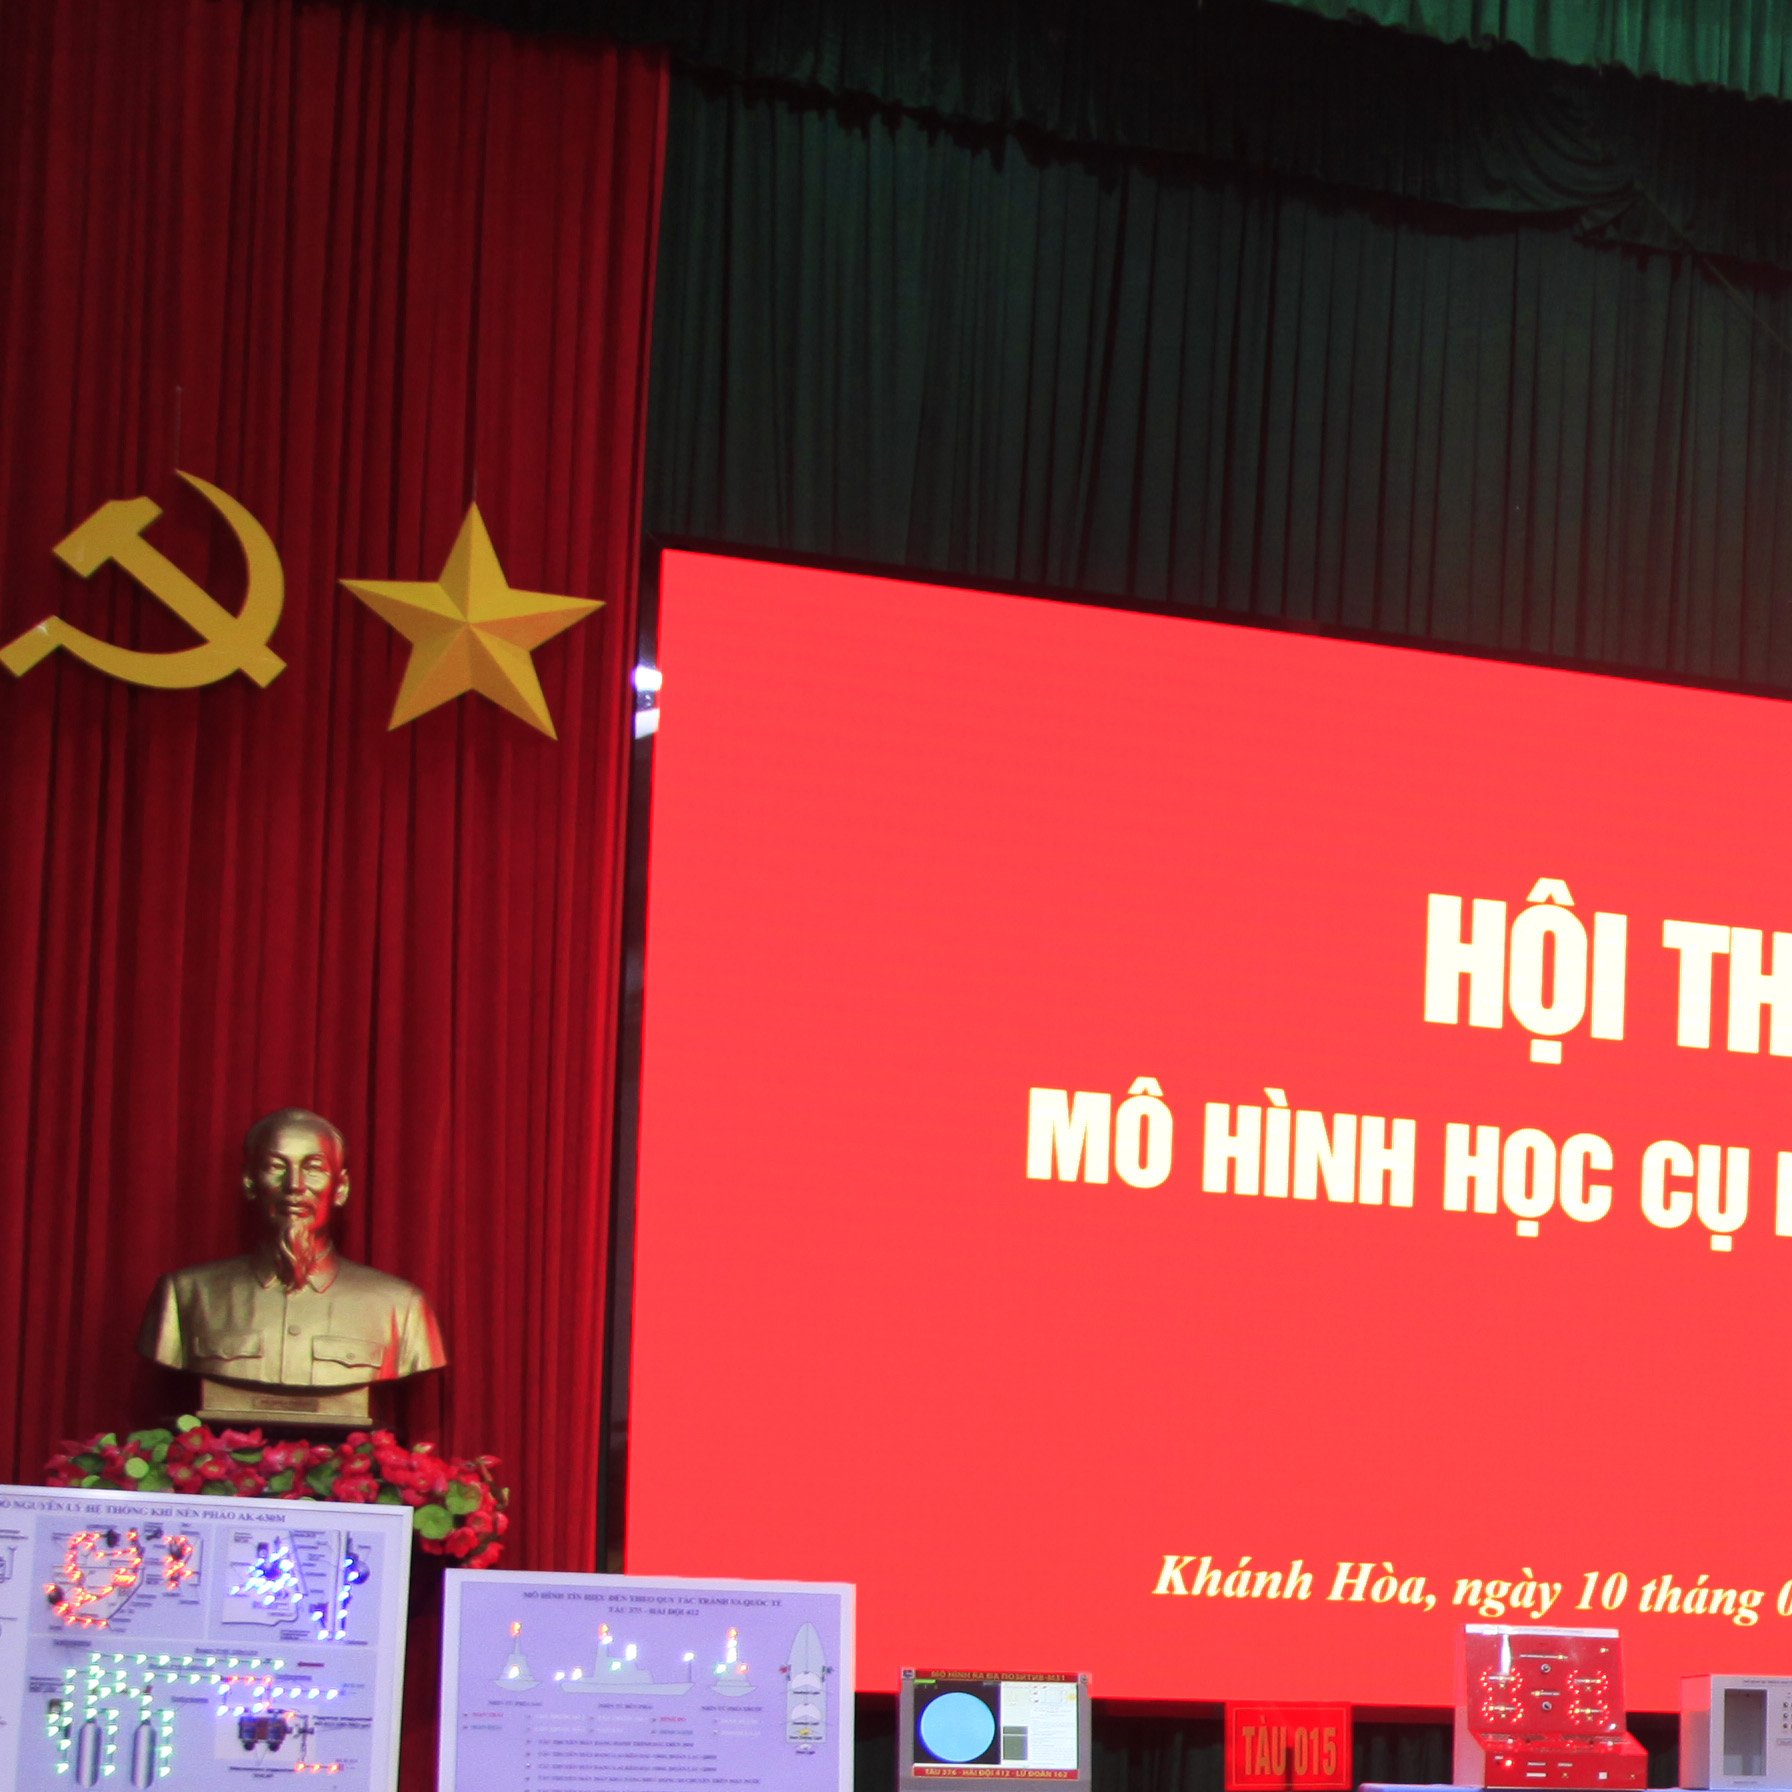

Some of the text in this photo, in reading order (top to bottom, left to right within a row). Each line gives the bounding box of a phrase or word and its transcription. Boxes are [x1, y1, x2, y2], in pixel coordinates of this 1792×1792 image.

[1424, 877, 1627, 1065] HỘI
[1026, 1076, 1174, 1189] MÔ
[1202, 1087, 1416, 1208] HÌNH
[1443, 1122, 1614, 1237] HỌC
[1641, 1139, 1750, 1253] CỤ
[1152, 1554, 1313, 1602] Khánh
[1327, 1561, 1437, 1612] Hòa,
[1452, 1570, 1562, 1619] ngày
[1575, 1571, 1628, 1611] 10
[1638, 1574, 1765, 1627] tháng
[1242, 1714, 1337, 1776] TÀU 015
